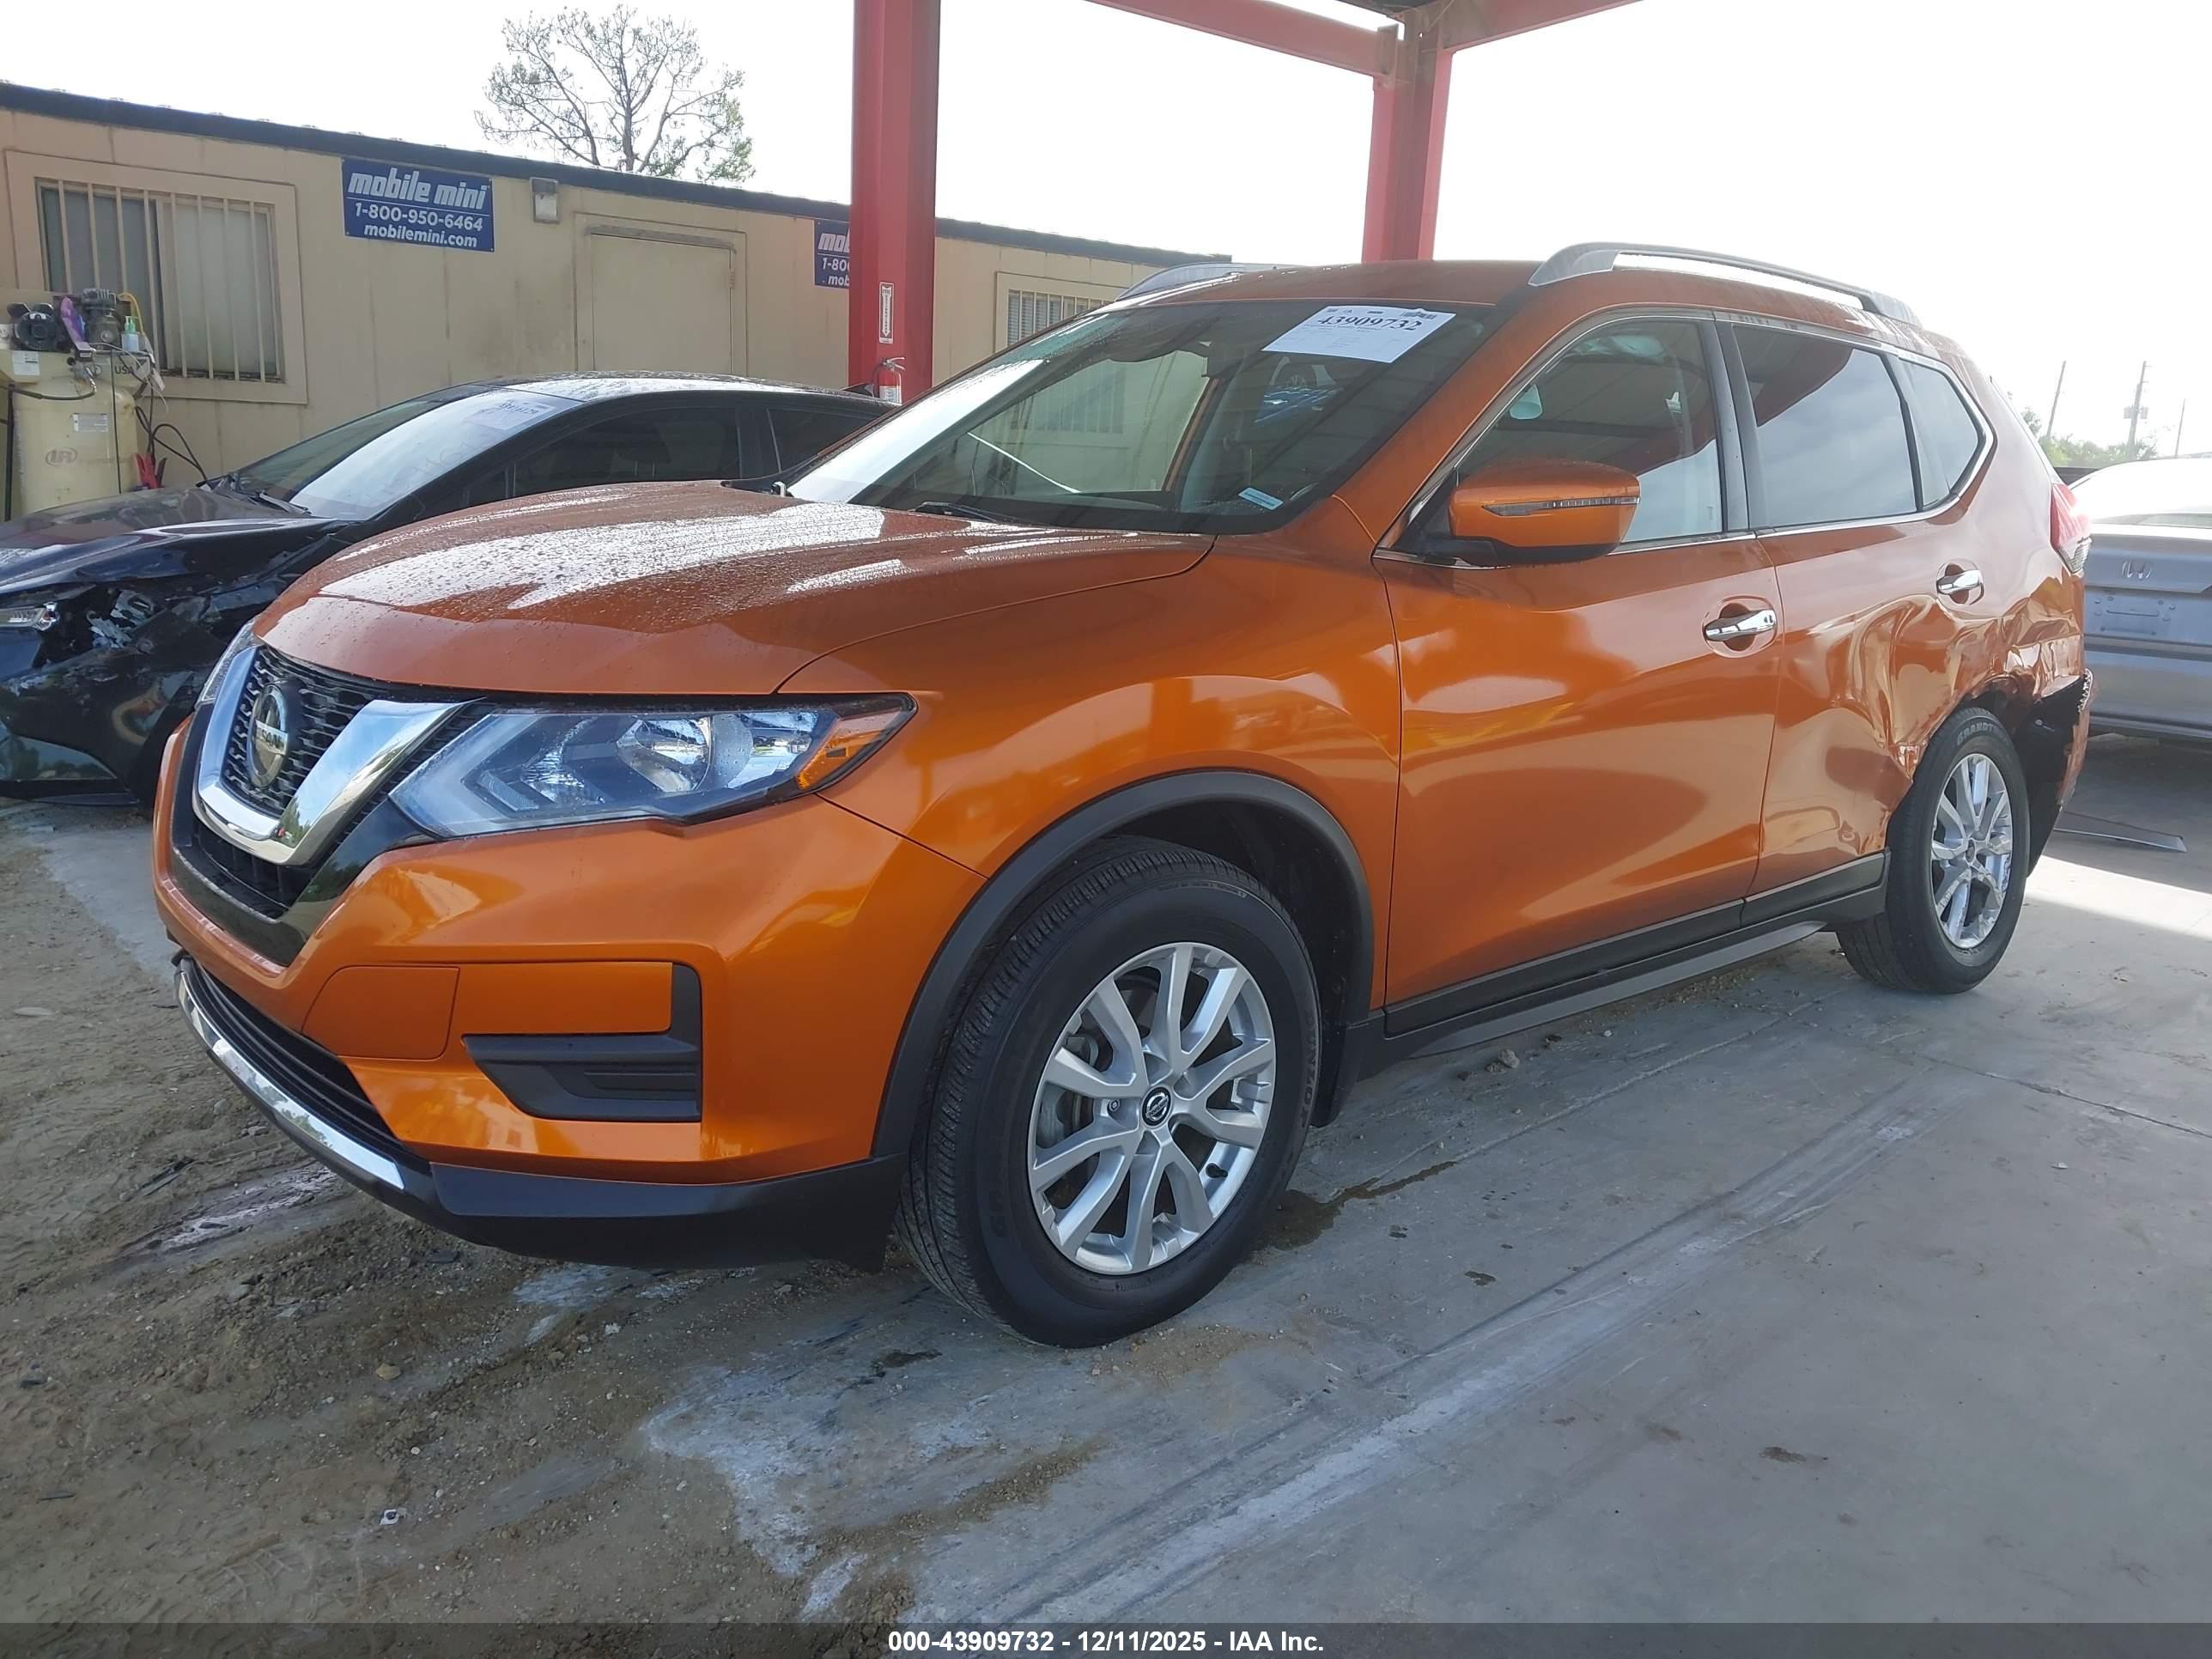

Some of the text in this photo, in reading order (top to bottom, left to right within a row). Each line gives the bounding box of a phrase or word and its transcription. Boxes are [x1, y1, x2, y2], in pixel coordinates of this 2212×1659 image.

[348, 167, 488, 210] mobile mini
[355, 202, 483, 231] 1-800-950-6464
[364, 224, 477, 247] mobilemini.com
[823, 258, 849, 271] 1-80
[1318, 315, 1422, 331] 43909732
